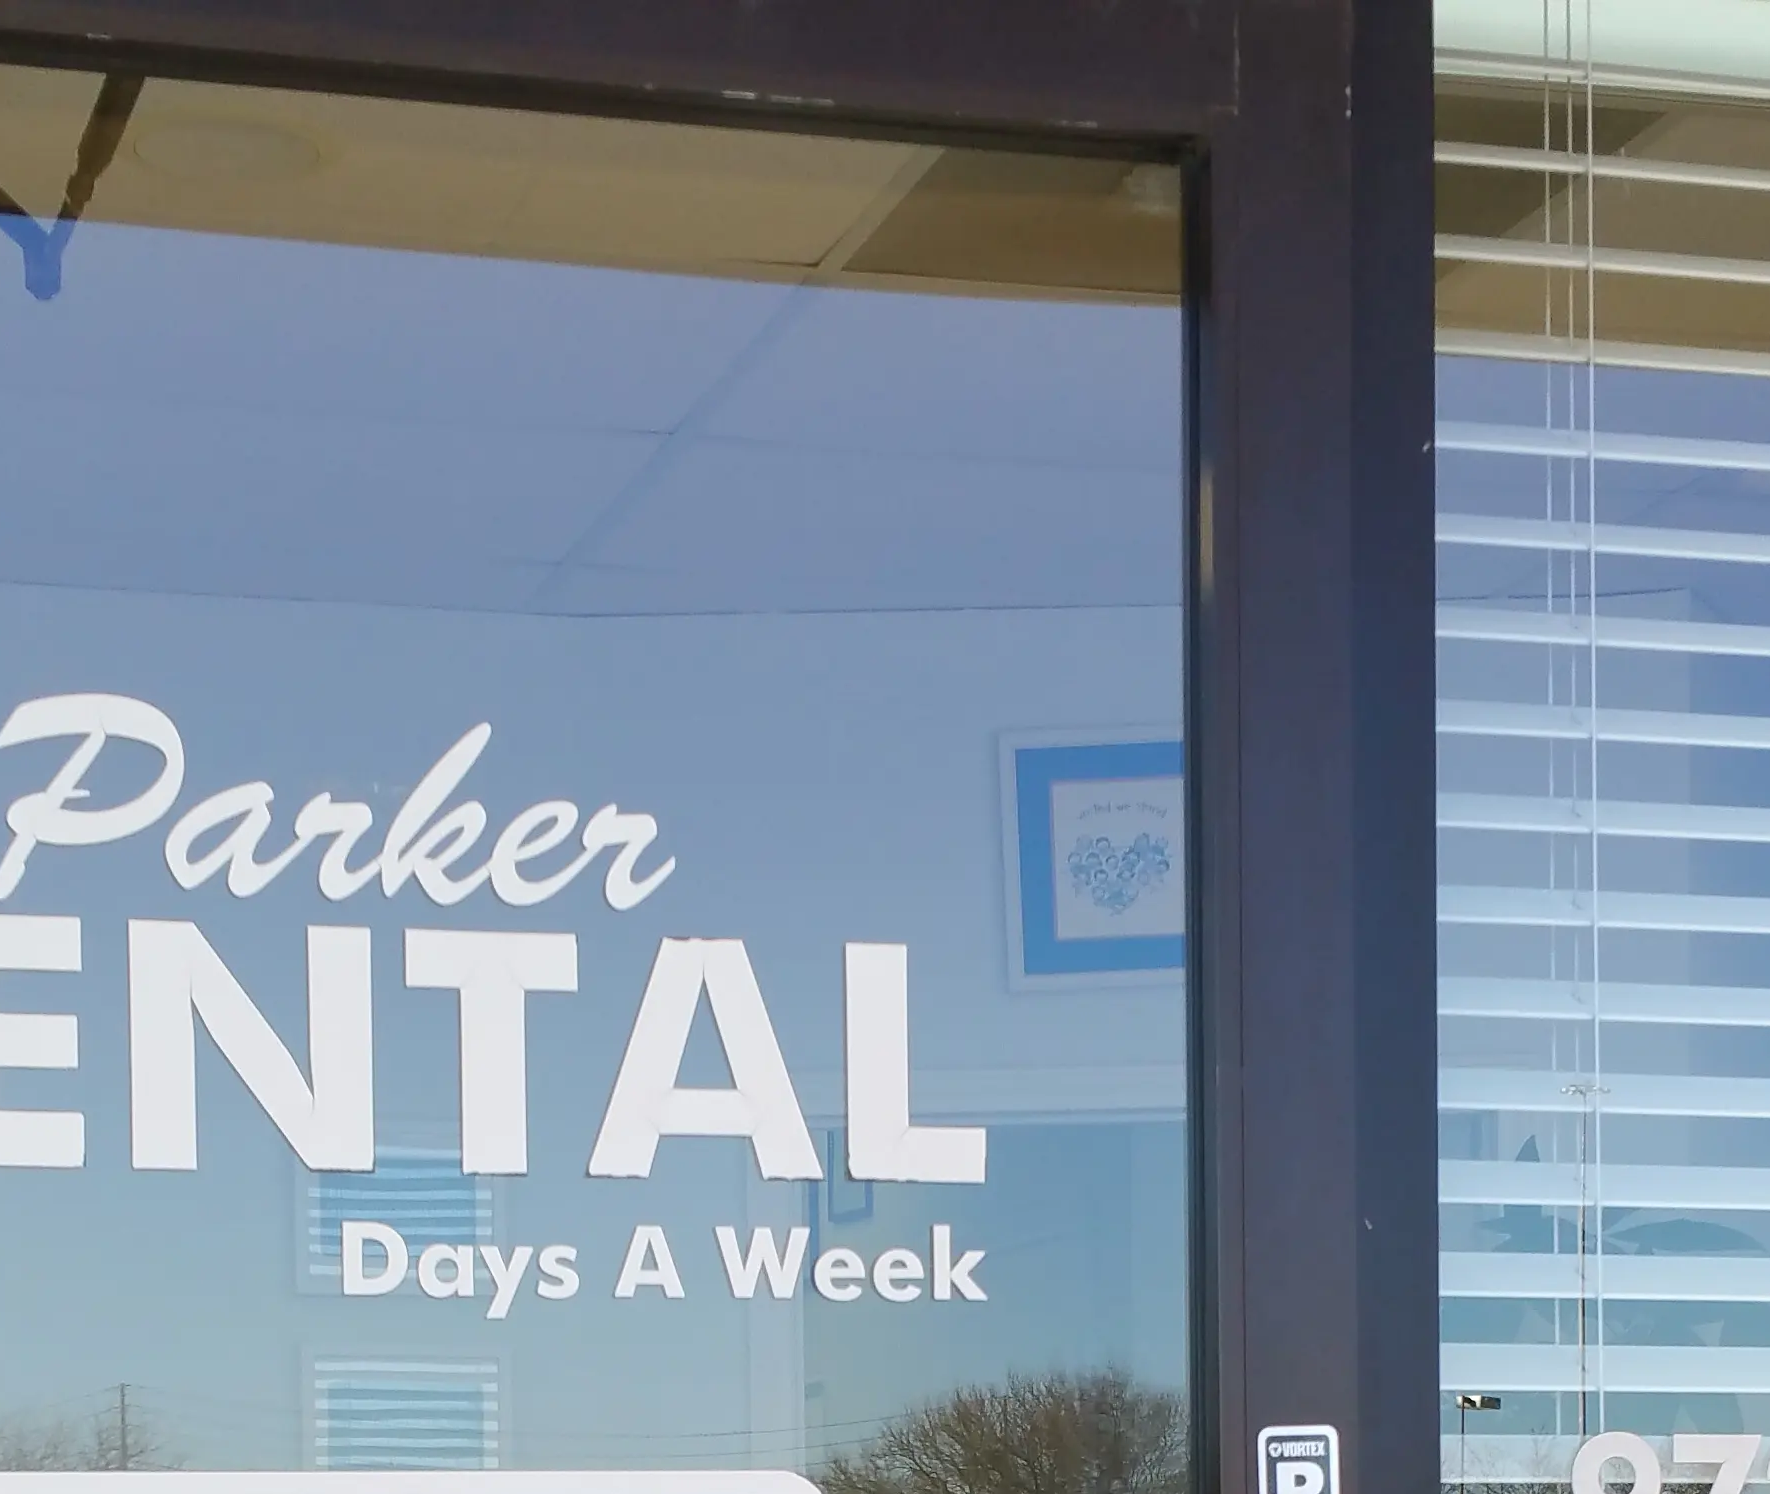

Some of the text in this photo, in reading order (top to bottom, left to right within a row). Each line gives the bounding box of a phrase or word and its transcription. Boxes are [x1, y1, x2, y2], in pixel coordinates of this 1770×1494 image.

[341, 1221, 579, 1319] Days
[614, 1224, 685, 1299] A
[715, 1224, 988, 1303] Week
[1282, 1441, 1325, 1457] VORTEX
